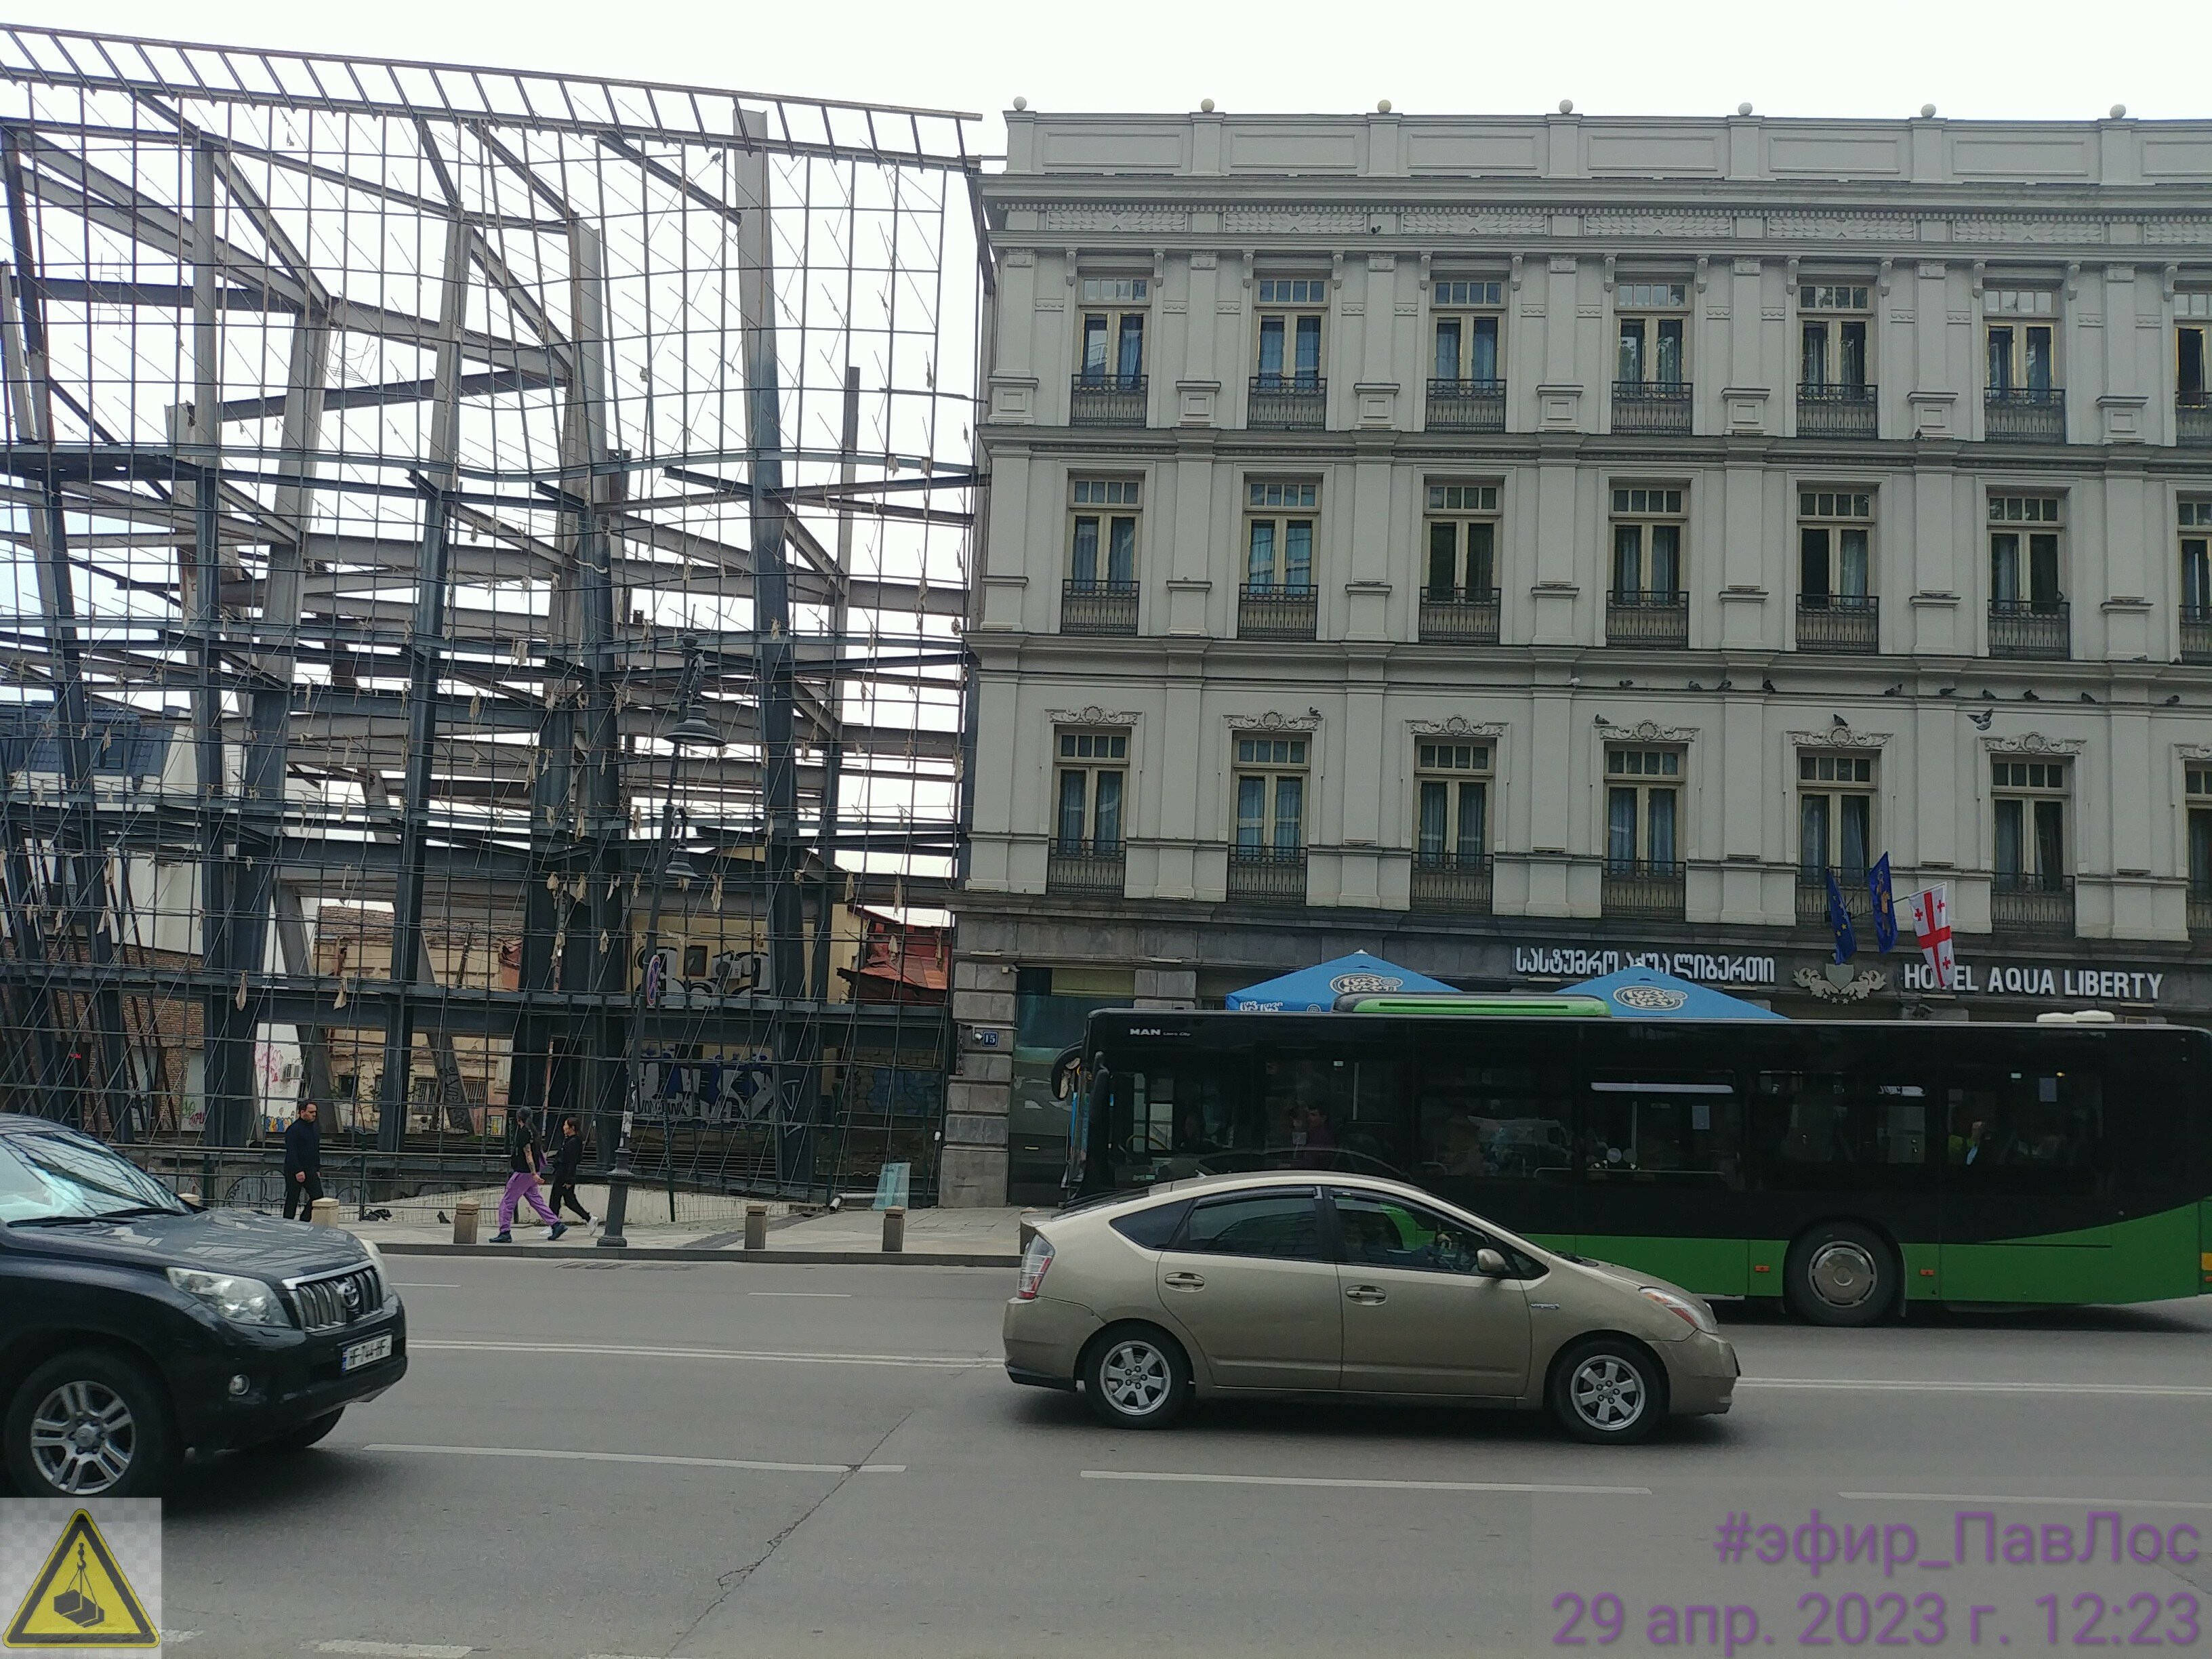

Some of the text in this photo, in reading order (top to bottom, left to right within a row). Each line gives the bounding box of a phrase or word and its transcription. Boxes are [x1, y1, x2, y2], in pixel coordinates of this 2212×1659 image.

[1516, 947, 1618, 976] სასტუმრო
[1904, 963, 2163, 999] HOEL AQUA LIBERTY
[985, 1034, 996, 1044] 15
